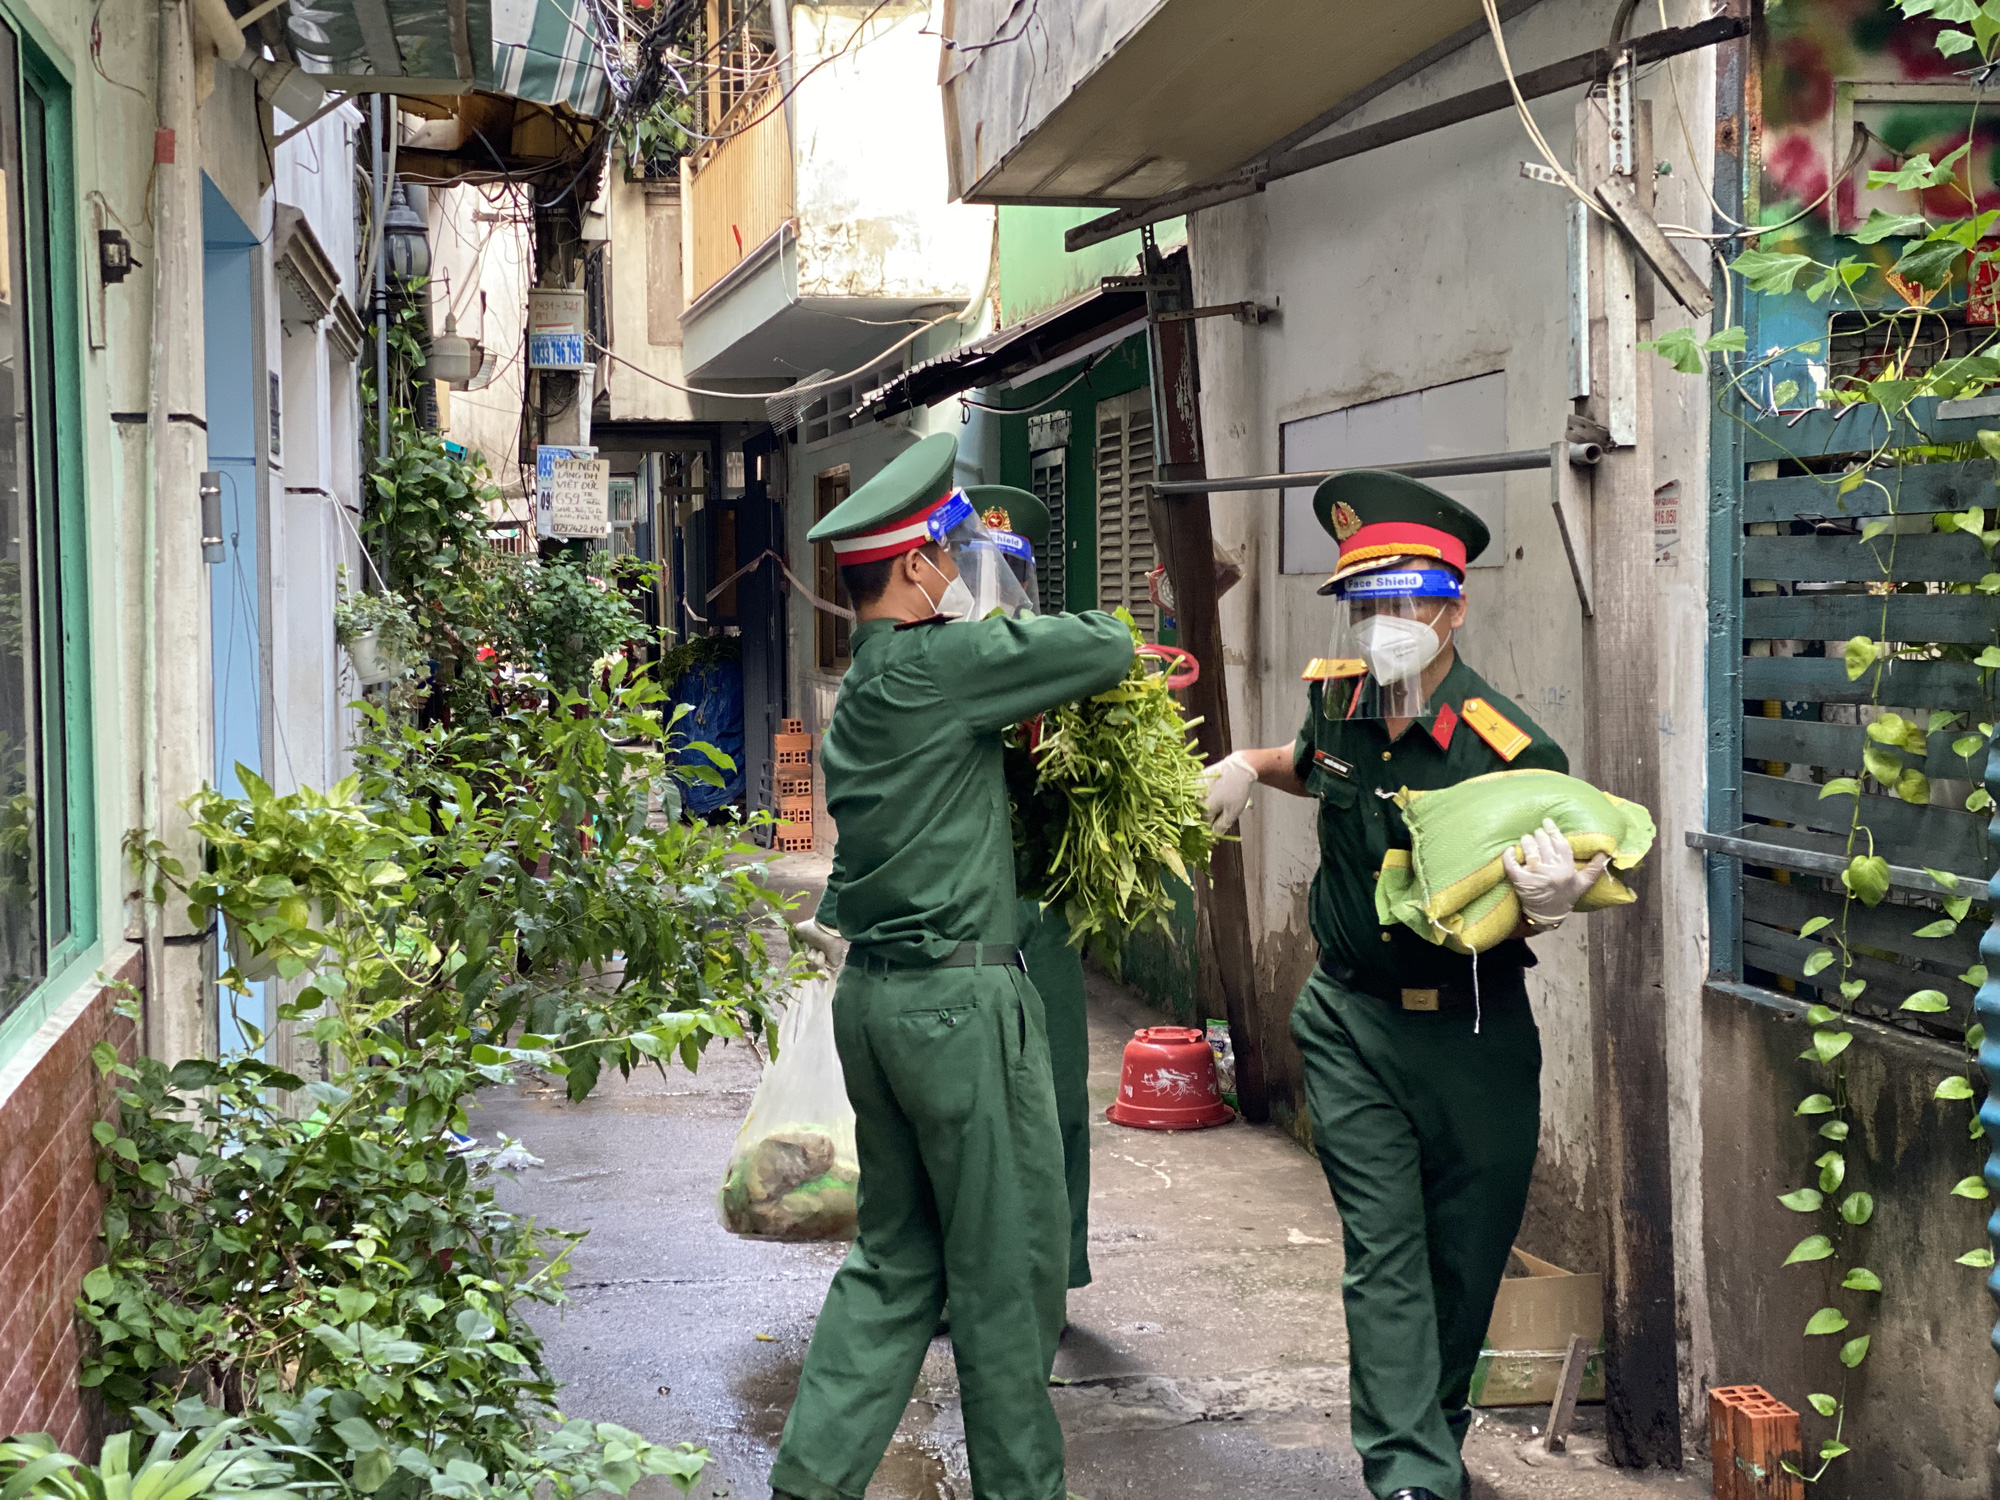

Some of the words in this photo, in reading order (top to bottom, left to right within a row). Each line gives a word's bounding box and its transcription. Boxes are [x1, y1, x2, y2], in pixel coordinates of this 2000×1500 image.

[531, 341, 582, 365] 0933.796.793
[578, 459, 601, 472] NỀN
[556, 479, 579, 491] VIỆT
[555, 491, 580, 505] 659
[1348, 579, 1372, 589] Face
[1376, 576, 1417, 587] Shield
